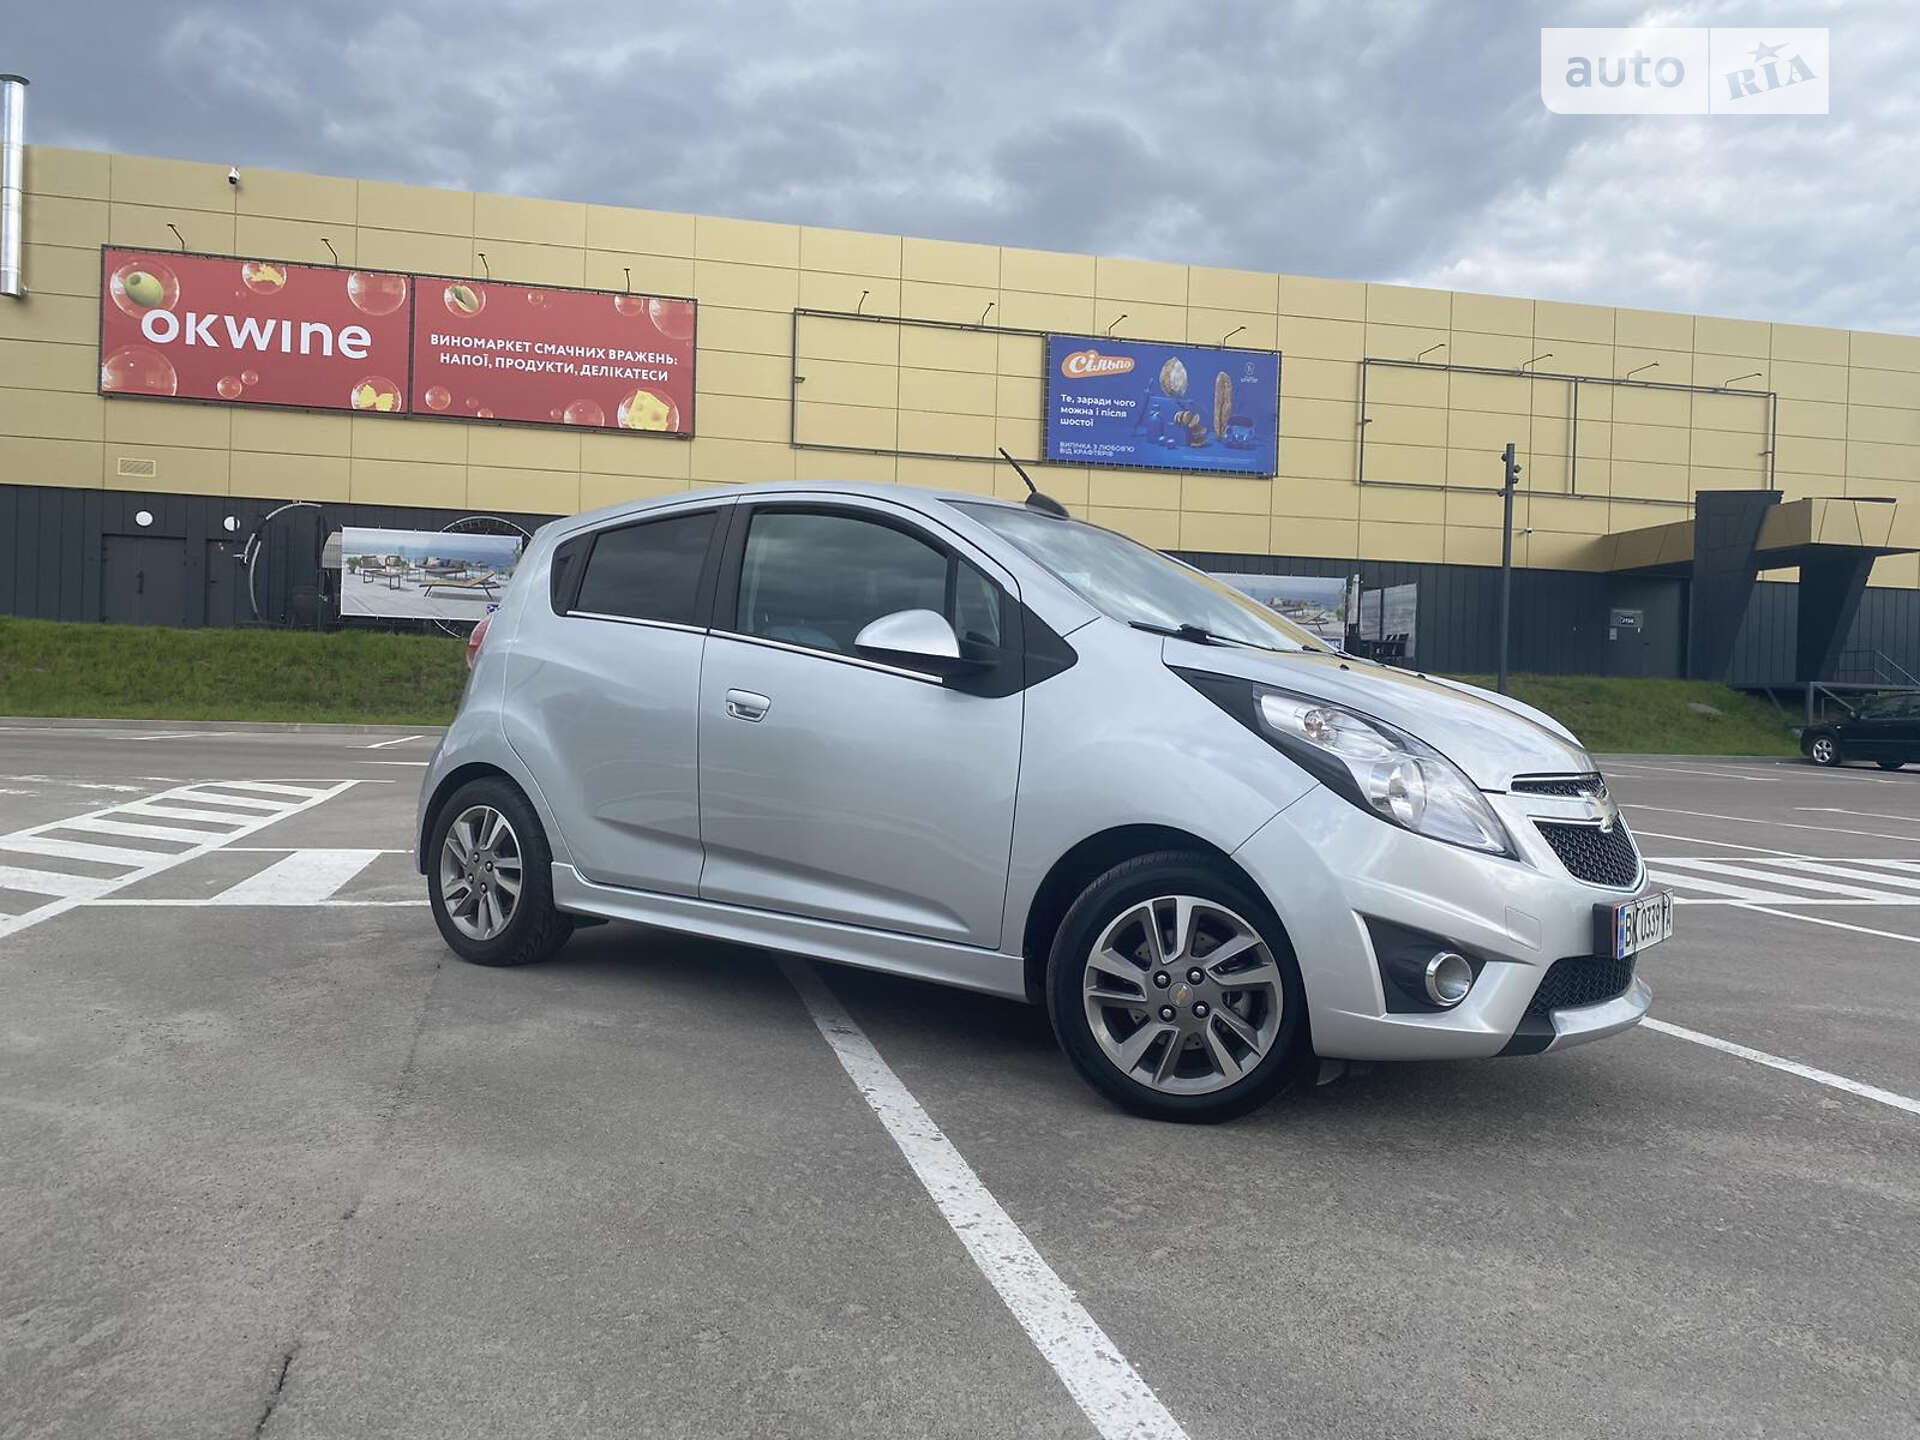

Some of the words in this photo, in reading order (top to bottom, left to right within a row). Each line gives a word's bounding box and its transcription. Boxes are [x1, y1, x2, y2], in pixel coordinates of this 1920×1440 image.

[431, 334, 532, 353] ВИНОМАРКЕТ
[534, 343, 606, 360] СМАЧНИХ
[608, 349, 678, 365] ВРАЖЕНЬ:
[440, 353, 493, 369] НАПОЇ,
[495, 357, 579, 376] ПРОДУКТИ,
[580, 364, 668, 382] ДЕЛІКАТЕСИ
[1069, 354, 1132, 373] Сільпо
[1060, 394, 1075, 403] Те,
[1077, 396, 1112, 406] заради
[1113, 399, 1136, 408] чого
[1060, 406, 1094, 416] можна
[1101, 408, 1127, 418] після
[1060, 418, 1094, 427] шостої
[1640, 903, 1660, 941] 0339
